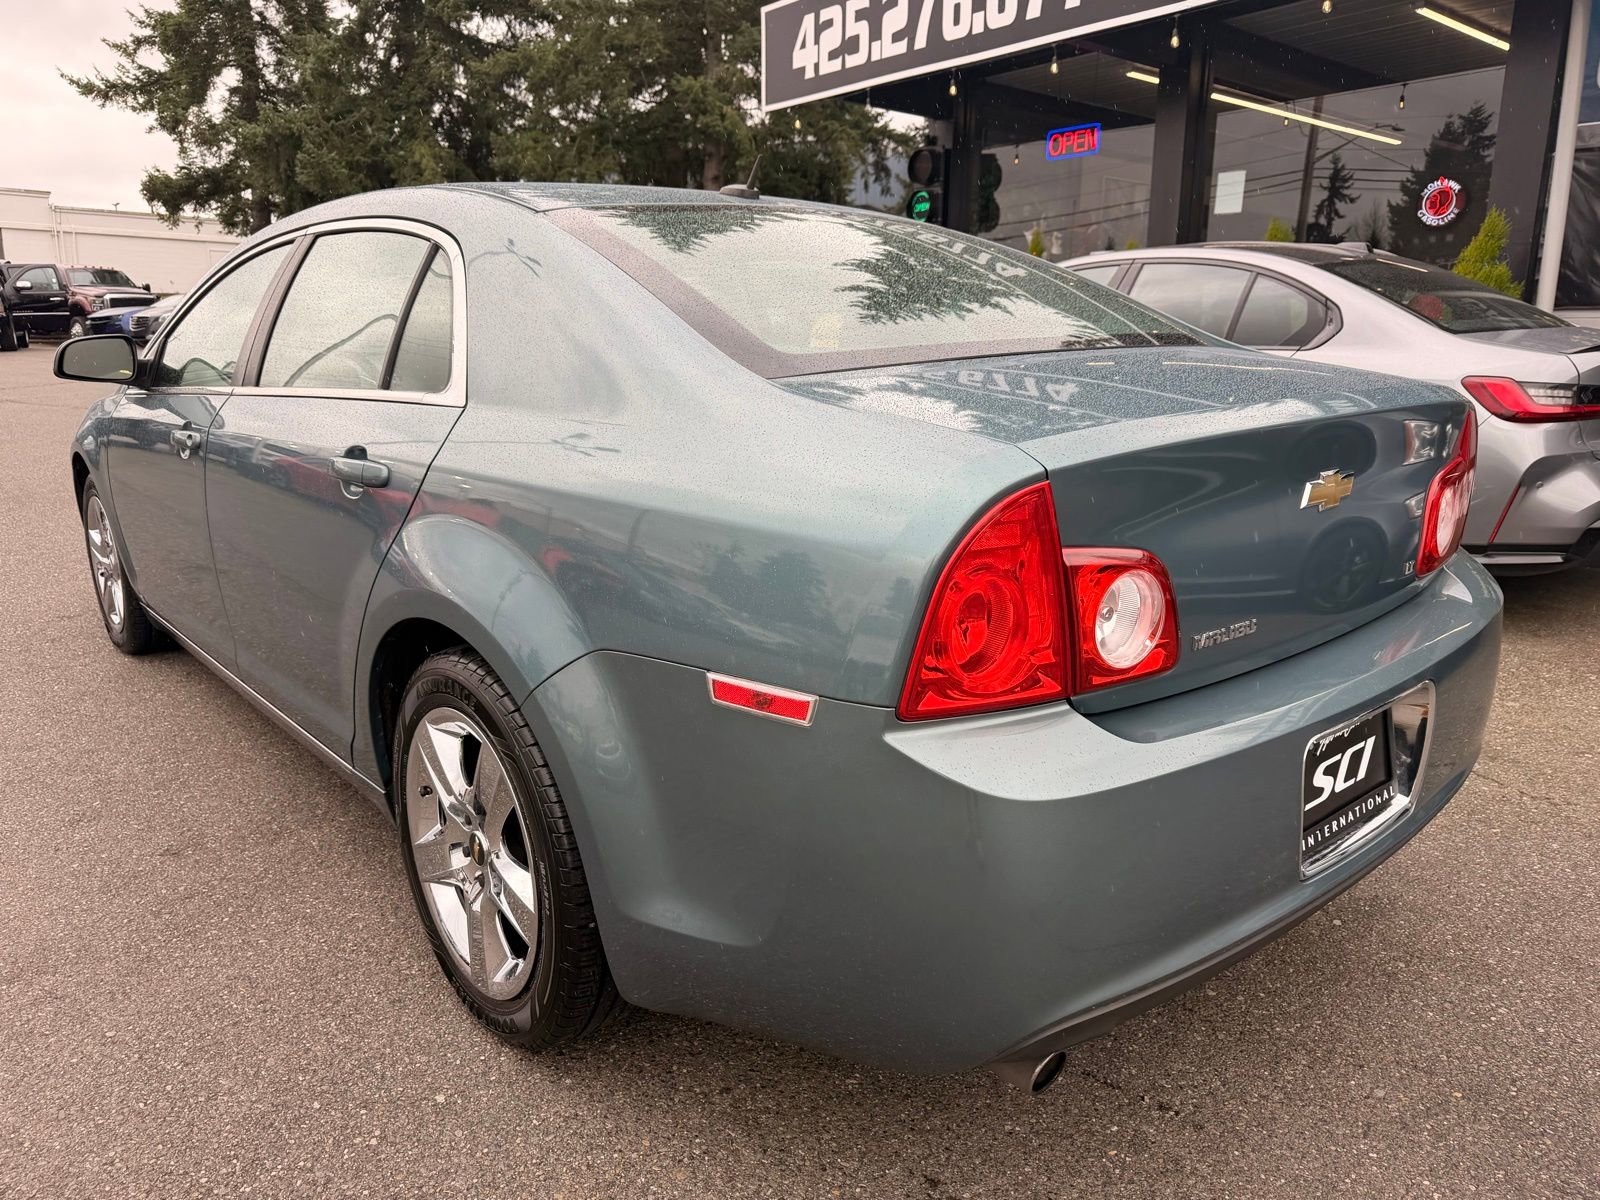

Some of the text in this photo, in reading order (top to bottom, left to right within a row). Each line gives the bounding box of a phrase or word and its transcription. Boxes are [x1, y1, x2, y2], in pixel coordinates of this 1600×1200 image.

[1049, 128, 1098, 157] OPEN
[1417, 207, 1460, 226] GASOLINE
[1192, 618, 1257, 651] MALIBU
[1304, 735, 1376, 812] SCI
[1302, 785, 1395, 851] INTERNATIONAL
